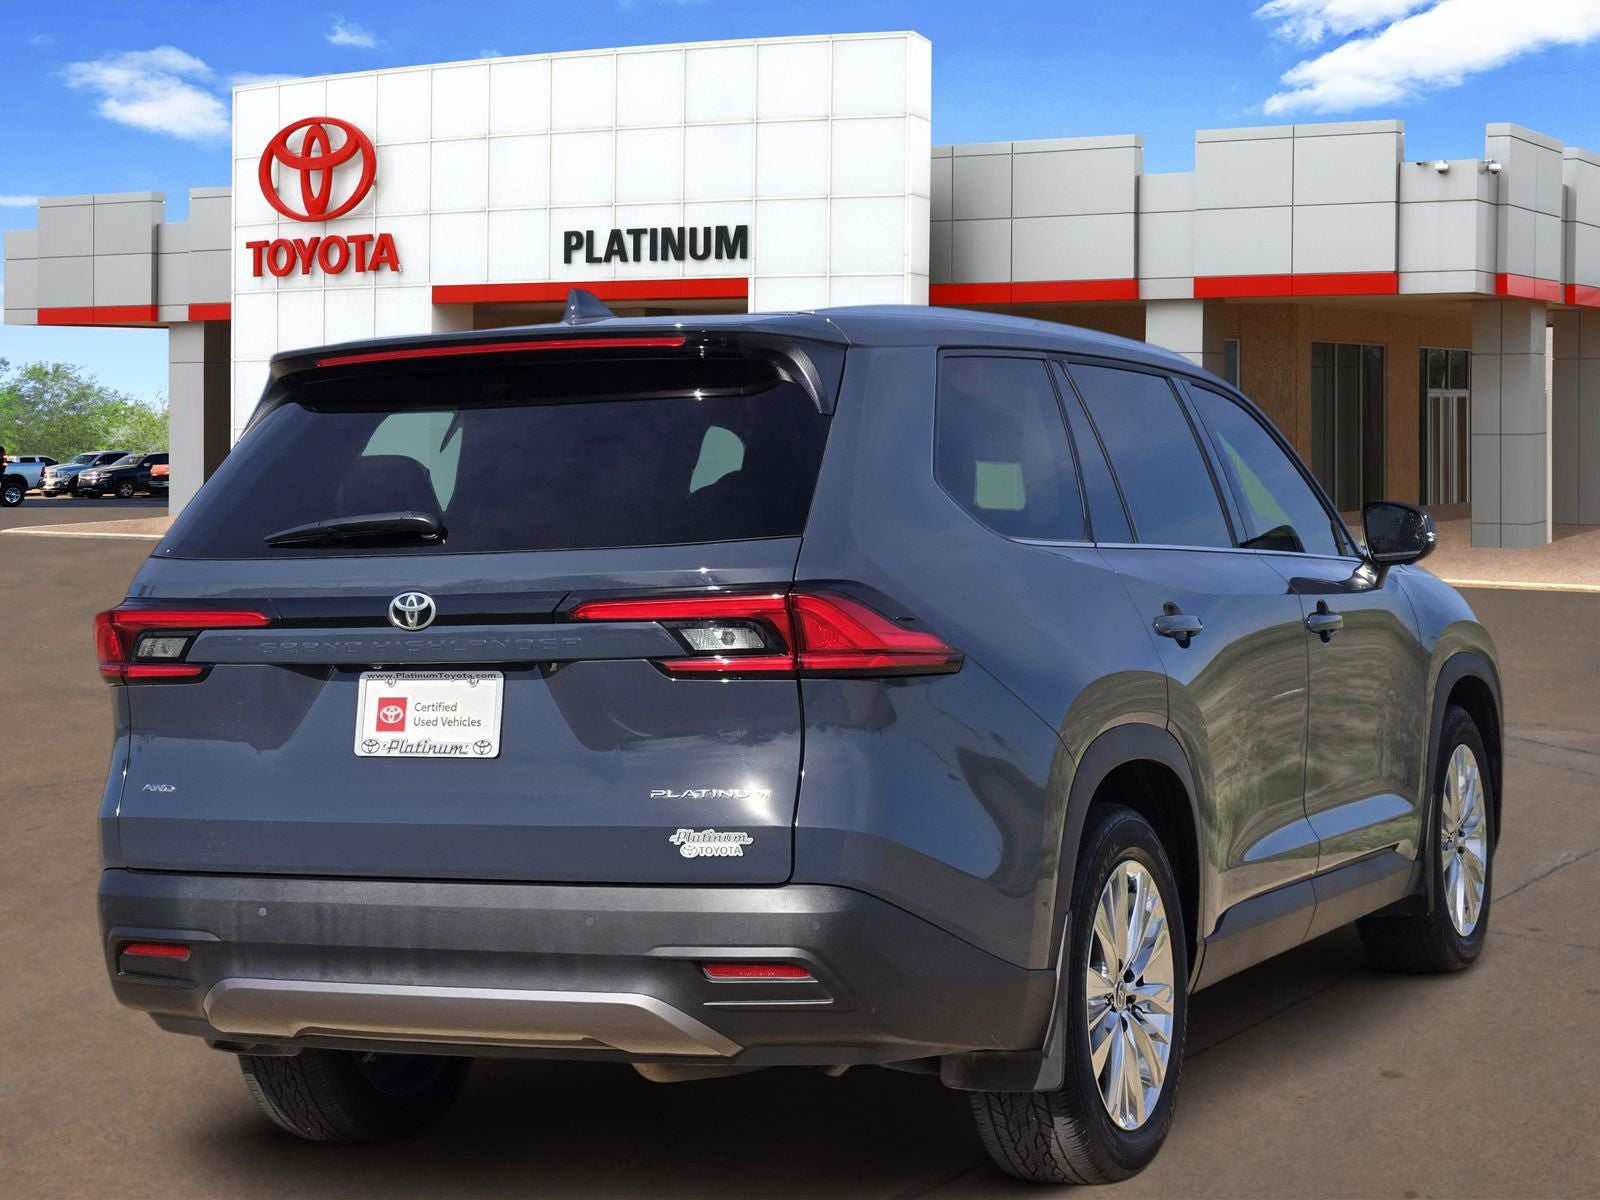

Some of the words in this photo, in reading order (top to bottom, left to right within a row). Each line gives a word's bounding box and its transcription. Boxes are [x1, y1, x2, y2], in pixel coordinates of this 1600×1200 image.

[563, 225, 749, 265] PLATINUM
[246, 233, 402, 278] TOYOTA
[259, 640, 362, 655] GRAND
[372, 637, 584, 655] HIGHLANDER
[366, 672, 497, 681] www.PlatinumToyota.com
[414, 702, 457, 712] Certified
[413, 717, 438, 727] Used
[441, 717, 482, 727] Vehicles
[386, 738, 469, 755] Platinum
[142, 783, 177, 792] AWD
[650, 789, 772, 799] PLATINUM
[674, 829, 749, 845] Platinum
[699, 845, 743, 857] TOYOTA
